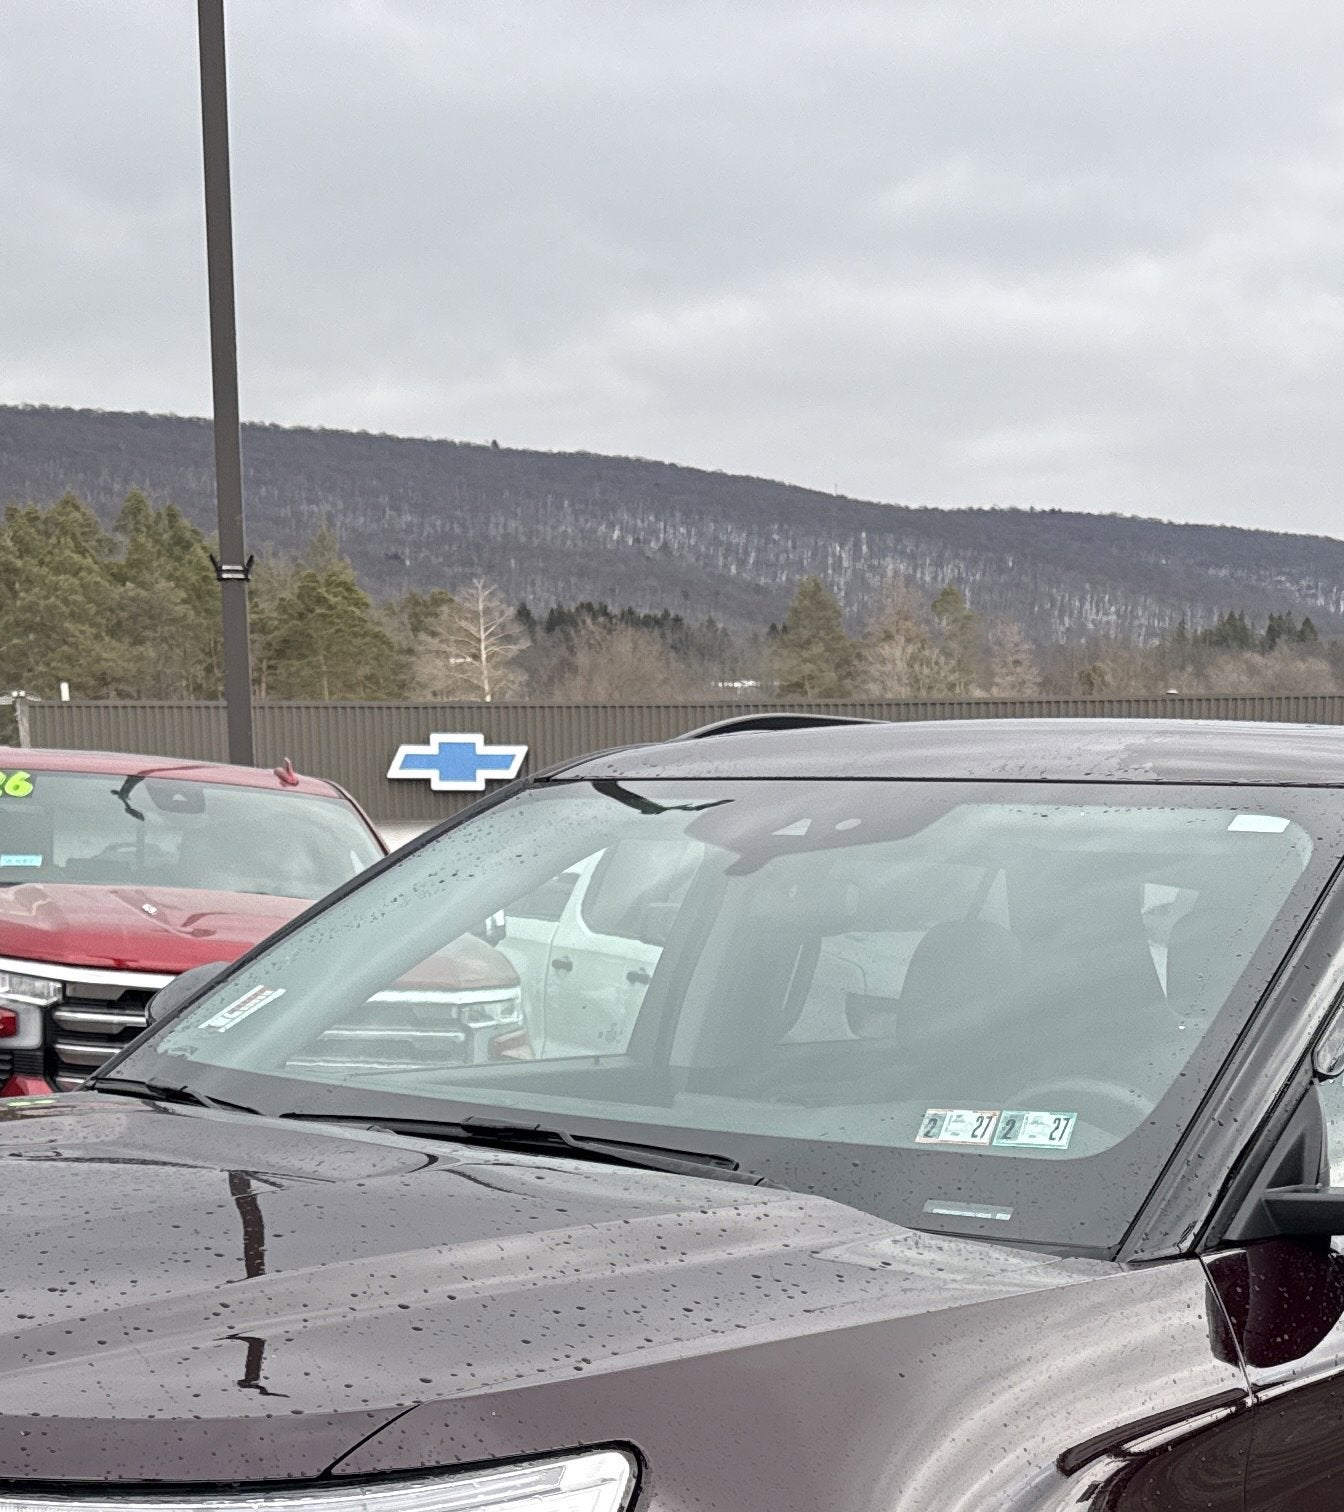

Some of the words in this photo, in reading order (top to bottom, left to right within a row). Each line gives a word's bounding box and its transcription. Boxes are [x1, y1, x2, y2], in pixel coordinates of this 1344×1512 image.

[923, 1117, 938, 1139] 2
[970, 1115, 994, 1139] 27
[1001, 1118, 1017, 1140] 2
[1048, 1117, 1071, 1142] 27
